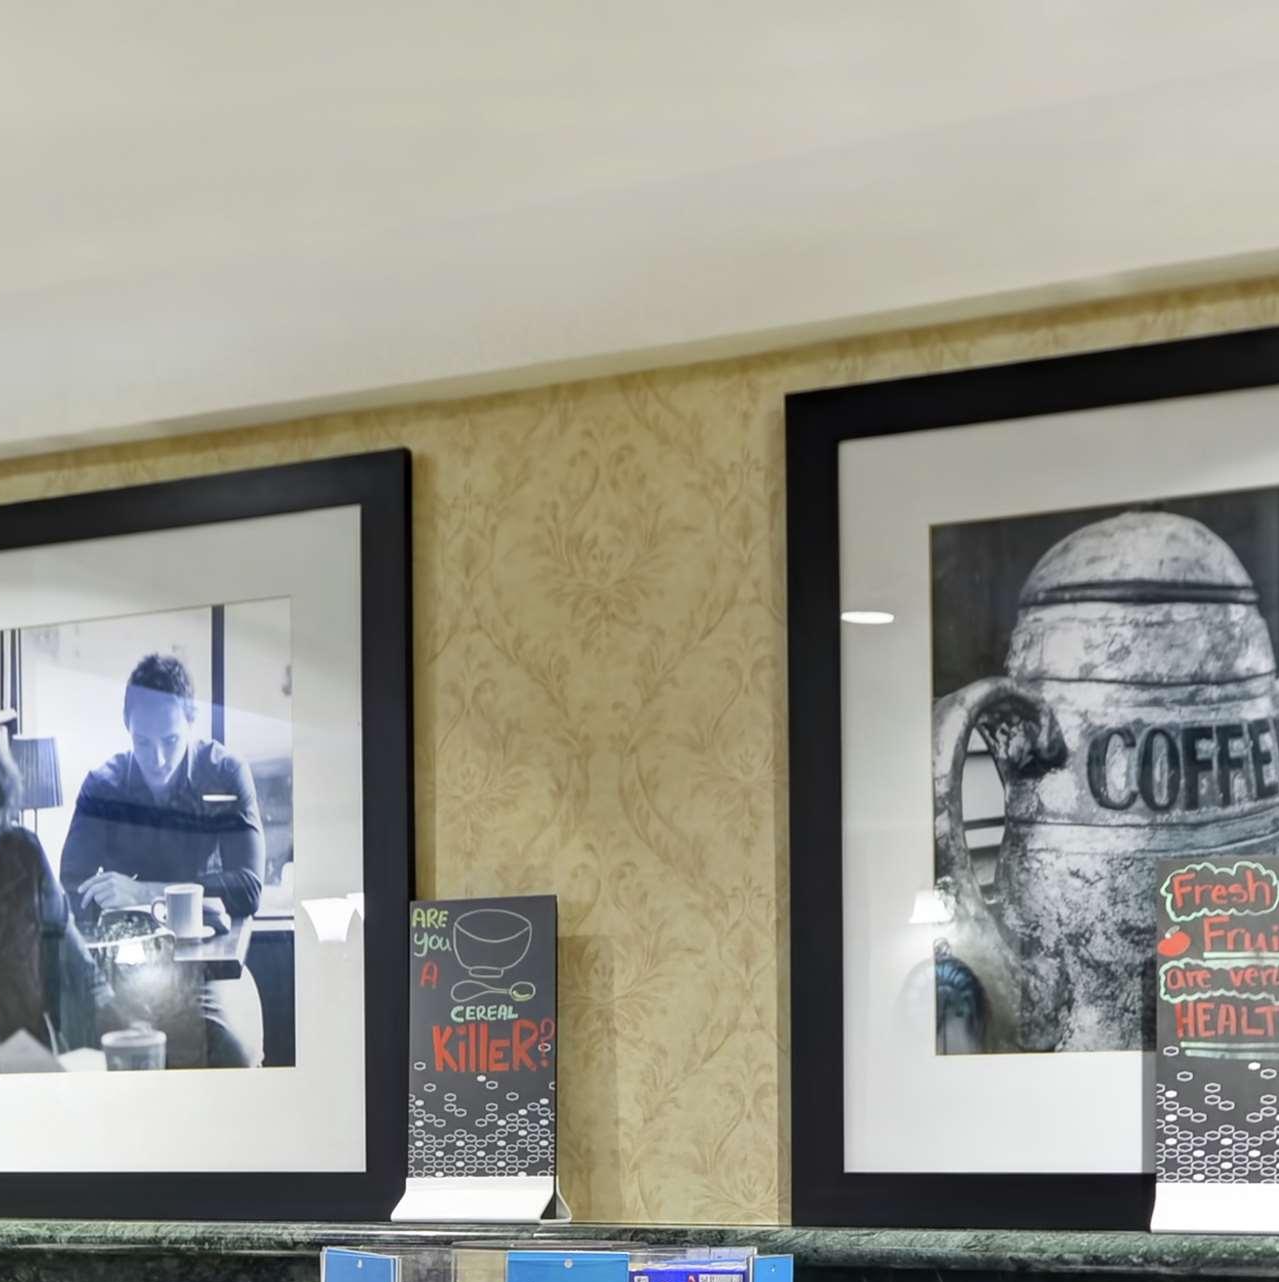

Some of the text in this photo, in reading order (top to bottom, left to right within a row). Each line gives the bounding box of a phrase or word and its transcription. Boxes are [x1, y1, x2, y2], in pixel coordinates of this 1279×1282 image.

[1173, 869, 1271, 908] Fresh
[411, 908, 449, 929] ARE
[420, 960, 439, 989] A
[1166, 968, 1212, 990] are
[451, 1005, 518, 1022] CEREAL
